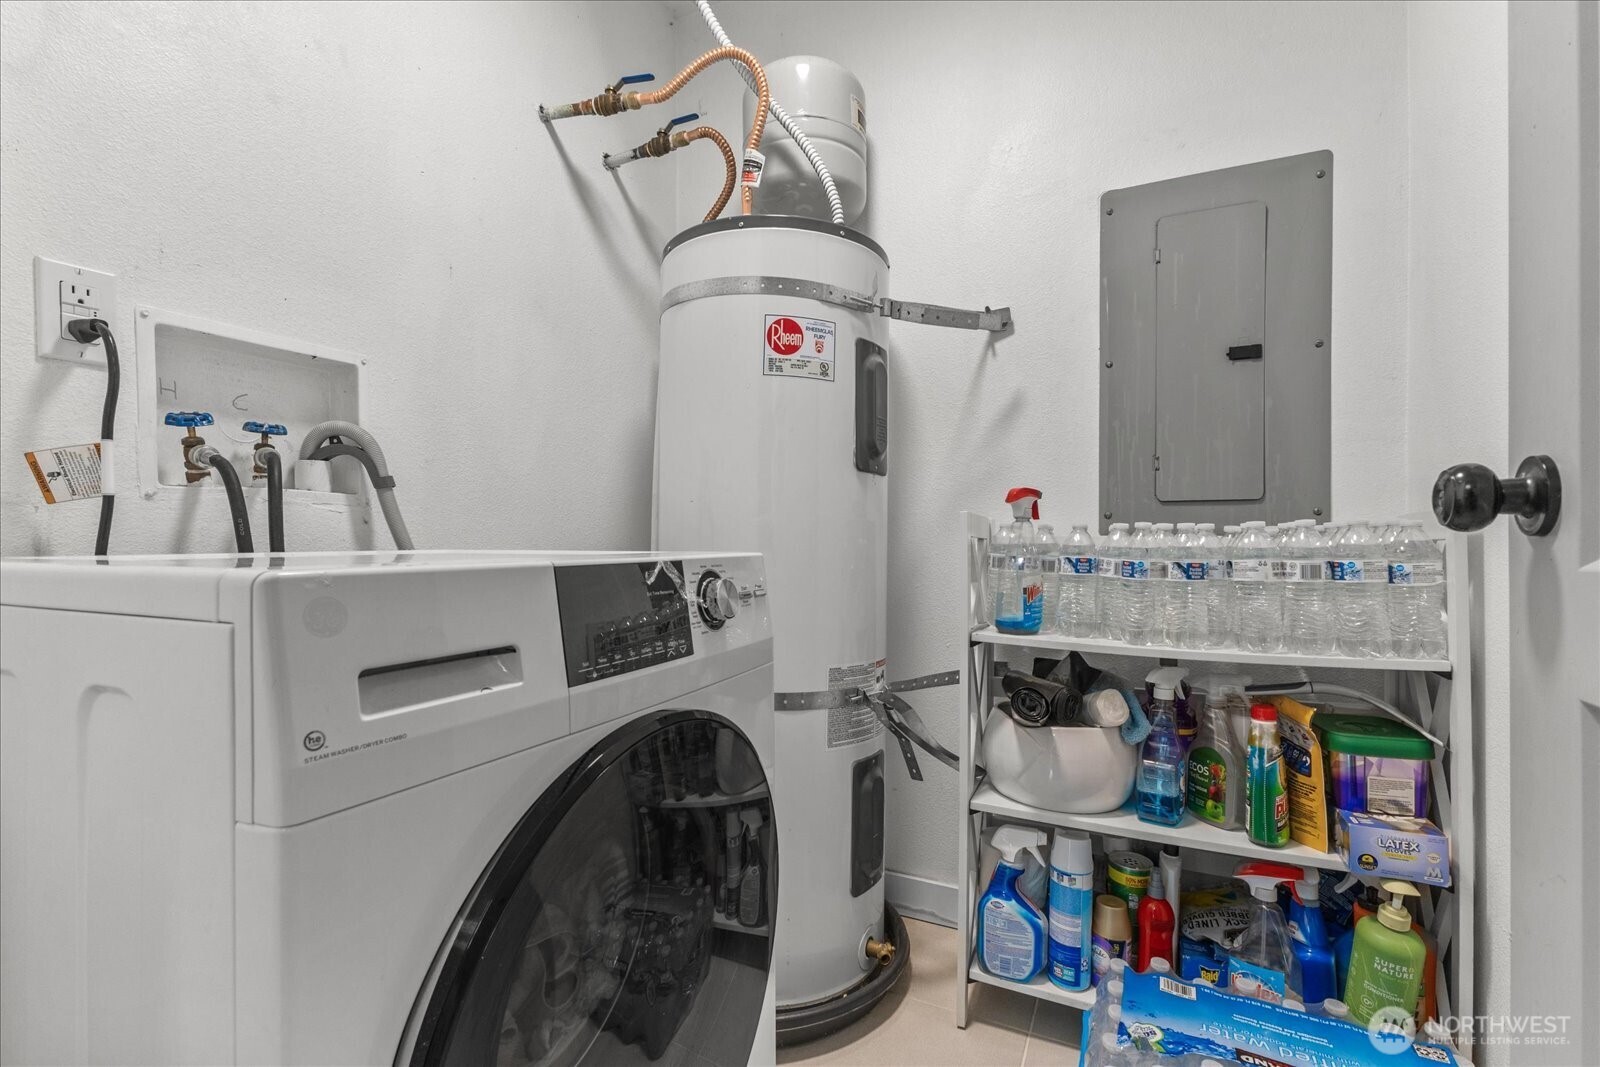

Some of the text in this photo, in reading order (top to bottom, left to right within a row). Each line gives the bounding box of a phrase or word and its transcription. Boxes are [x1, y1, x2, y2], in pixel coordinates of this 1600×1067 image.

[771, 319, 802, 350] Rheem
[159, 377, 177, 400] H
[233, 393, 248, 411] C
[304, 733, 408, 764] STEAM WASHER/DRYER COMBO
[308, 735, 322, 746] he
[1189, 760, 1209, 776] ECOS
[1378, 838, 1420, 853] LATEX
[1426, 866, 1442, 879] M
[1188, 918, 1220, 930] LINED
[1374, 956, 1408, 973] SUPER
[1374, 962, 1414, 980] NATURE
[1201, 970, 1218, 984] Raid
[1364, 983, 1404, 1004] CONDITIONER
[1199, 1023, 1270, 1051] Water
